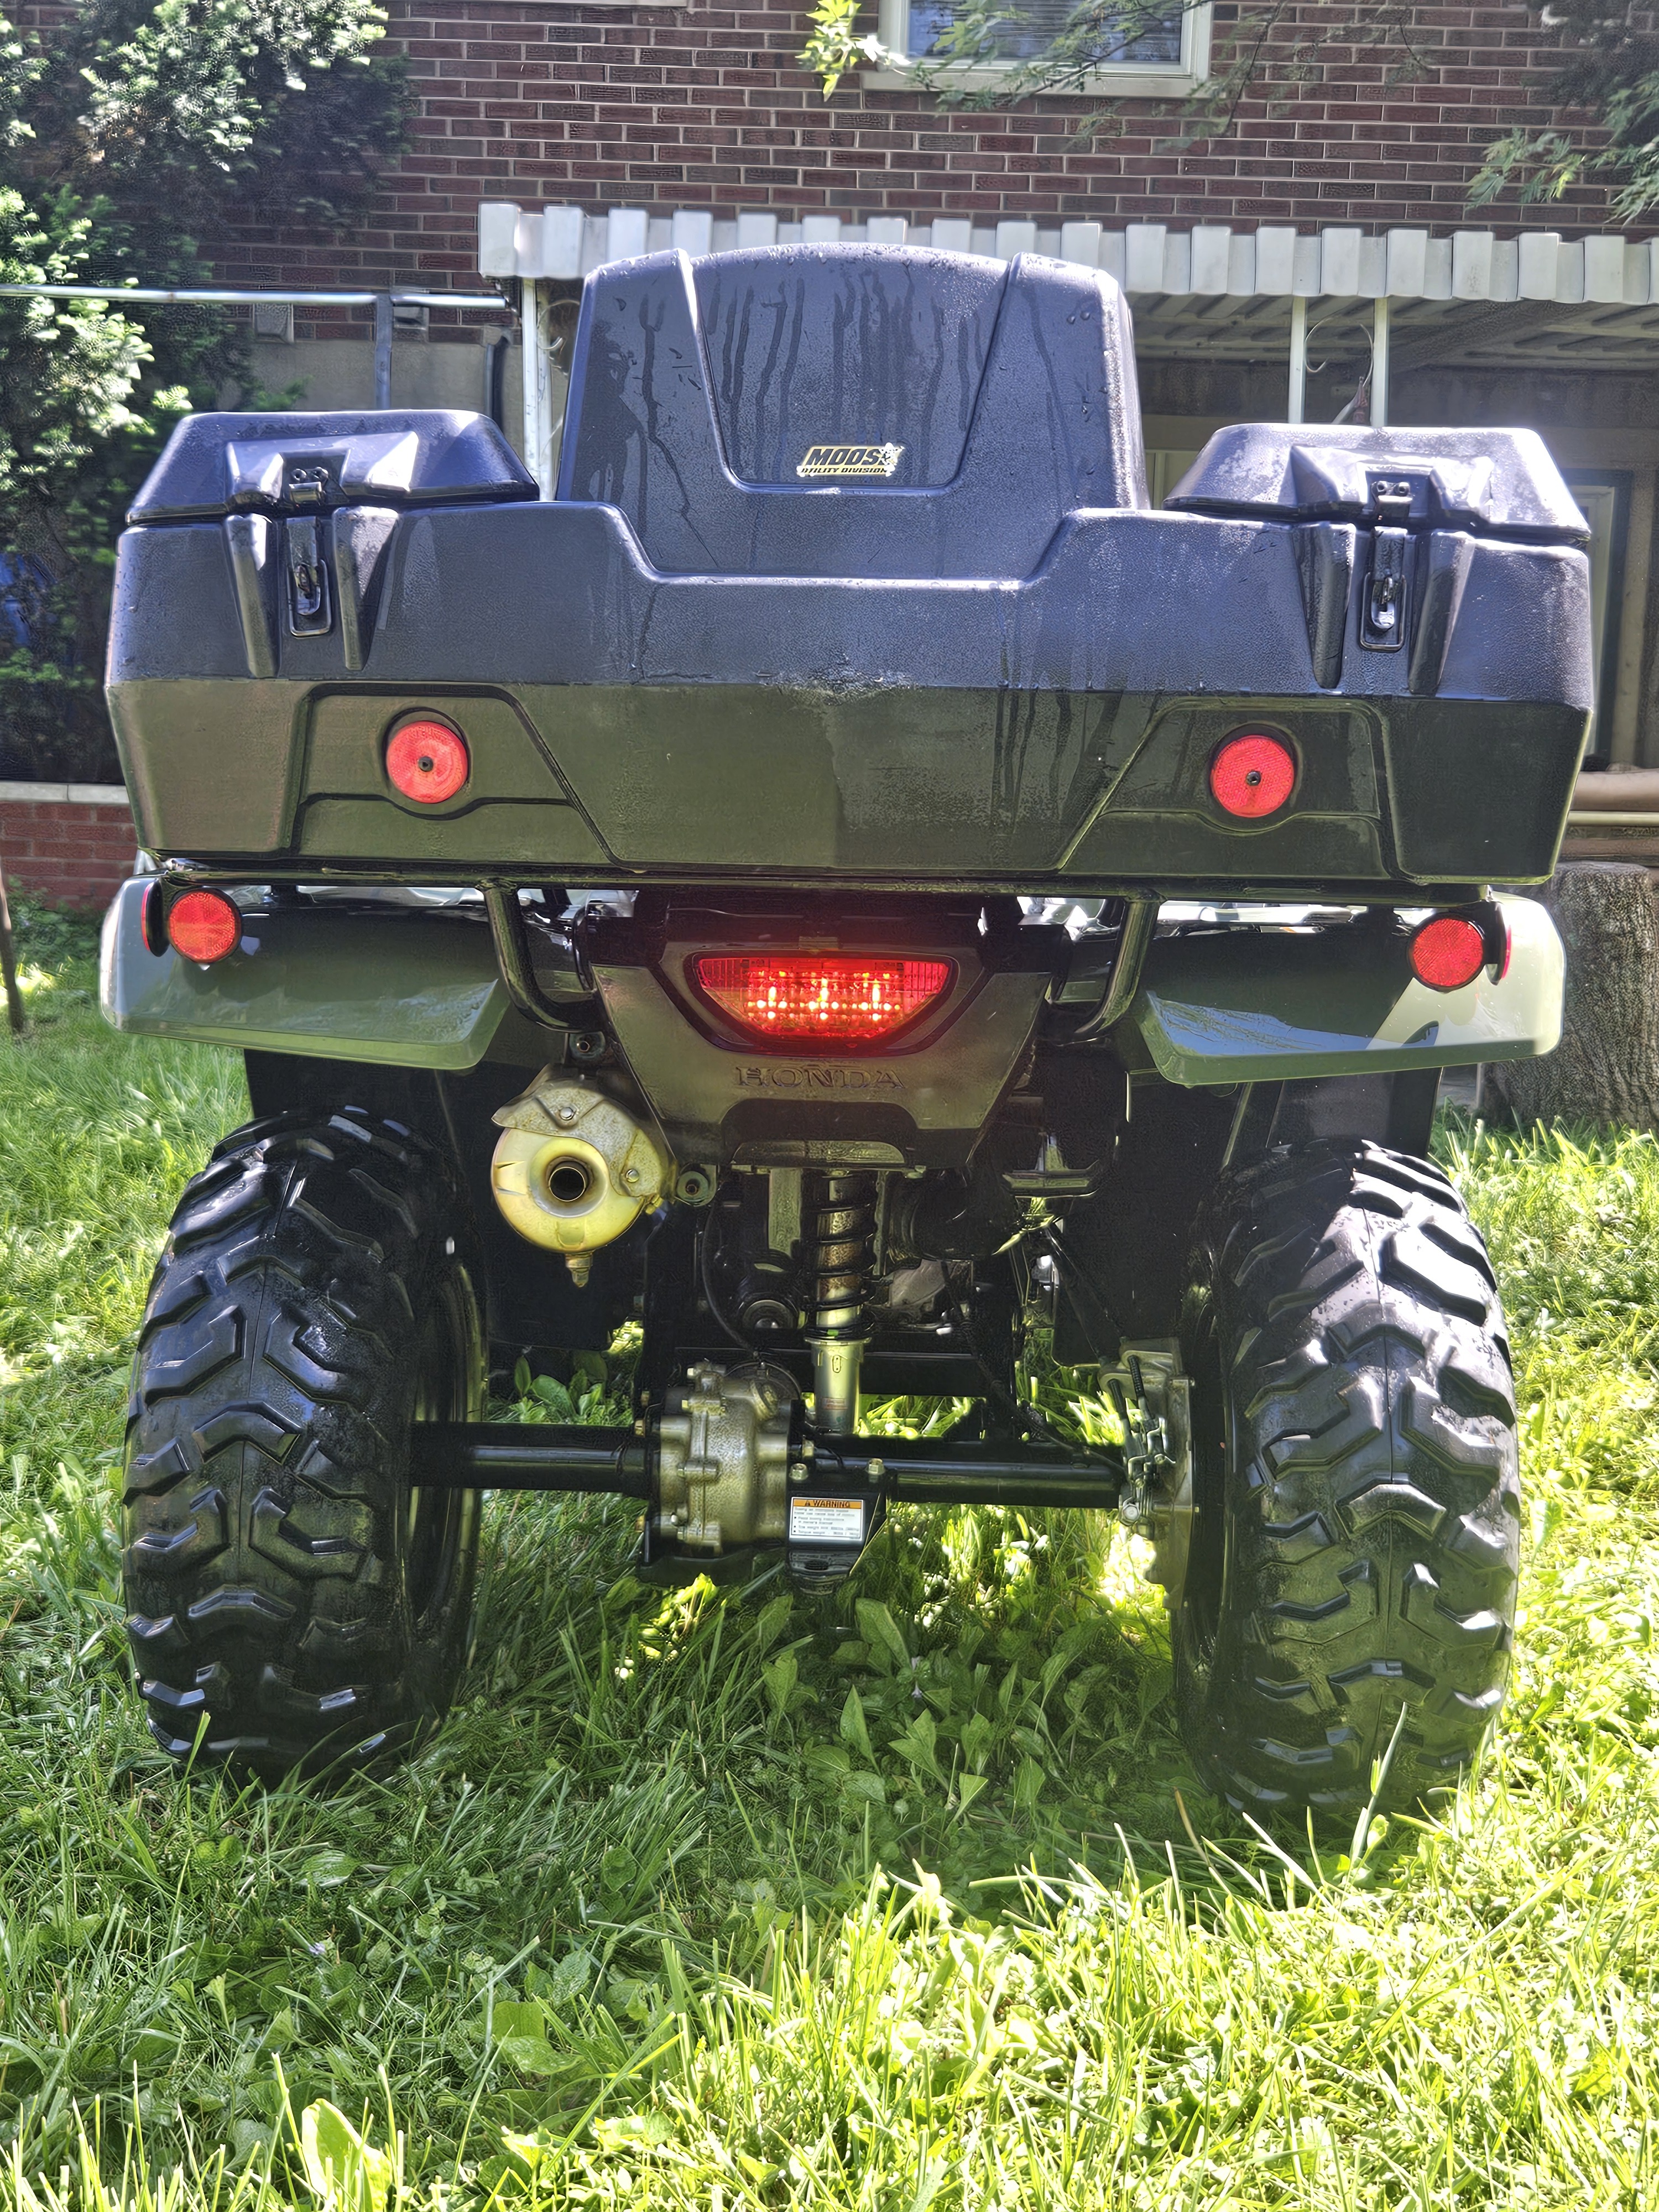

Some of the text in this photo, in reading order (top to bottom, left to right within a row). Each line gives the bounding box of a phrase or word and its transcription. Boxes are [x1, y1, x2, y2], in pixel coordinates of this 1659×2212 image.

[805, 449, 888, 466] MOOS
[735, 1067, 906, 1089] HONDA
[813, 1500, 851, 1508] WARNING
